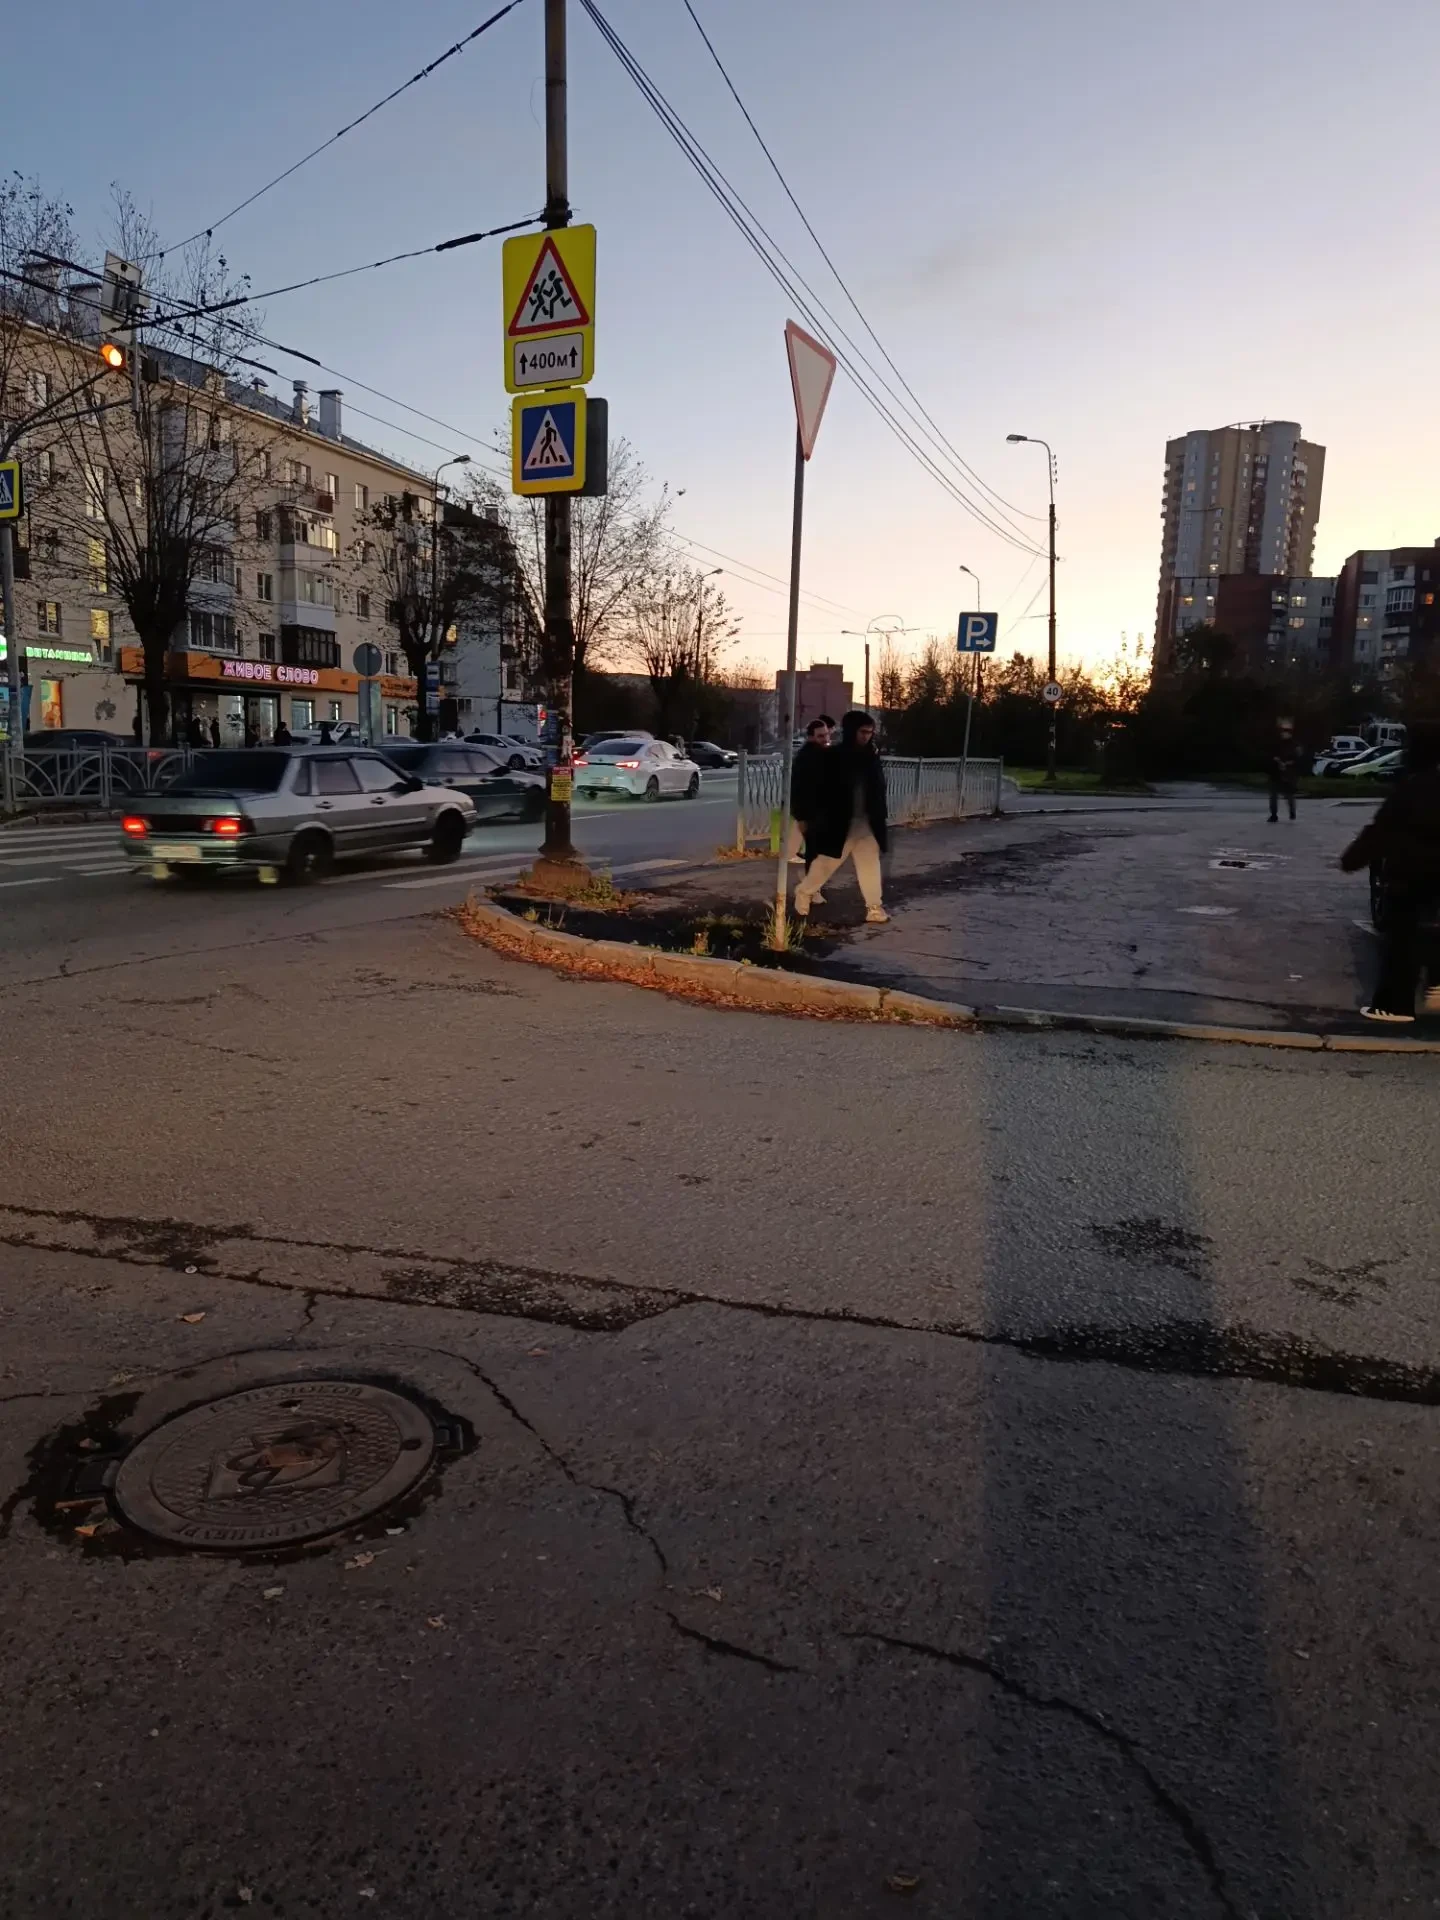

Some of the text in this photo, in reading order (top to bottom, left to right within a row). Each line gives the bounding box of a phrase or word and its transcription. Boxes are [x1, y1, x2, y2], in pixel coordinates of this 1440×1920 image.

[529, 351, 568, 369] 400м
[965, 616, 989, 648] P
[223, 660, 319, 685] ЖИВОЕ СЛОВО
[1046, 687, 1059, 697] 40
